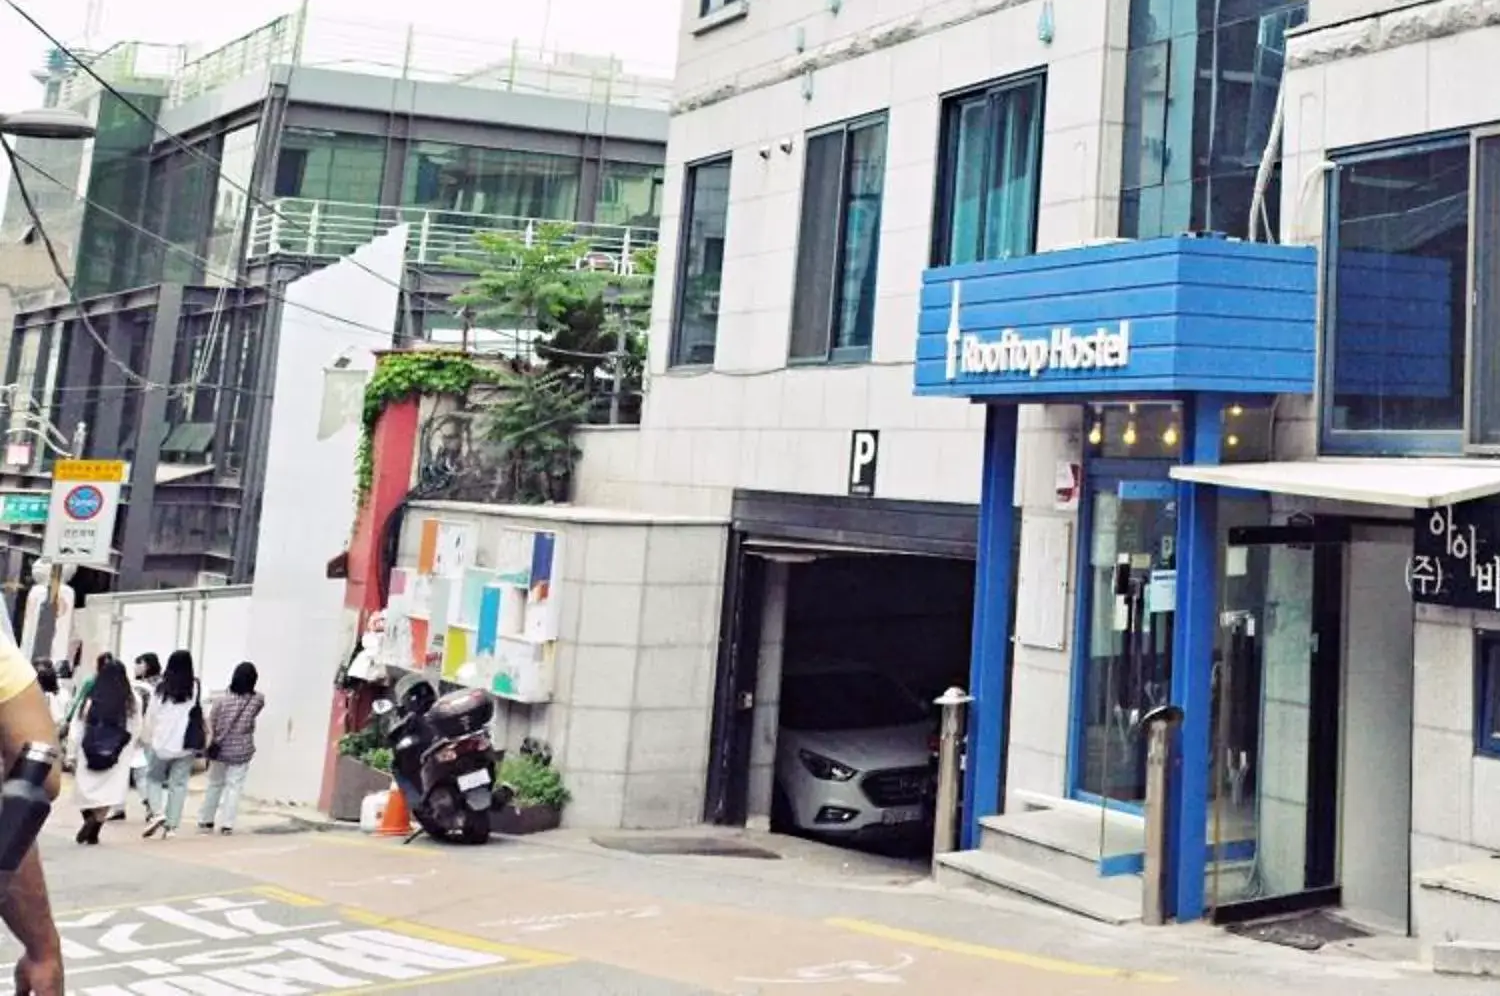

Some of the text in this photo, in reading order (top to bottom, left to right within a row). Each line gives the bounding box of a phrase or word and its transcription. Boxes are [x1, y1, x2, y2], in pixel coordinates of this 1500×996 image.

[961, 318, 1129, 377] Rooftop Hostel
[852, 431, 875, 485] P
